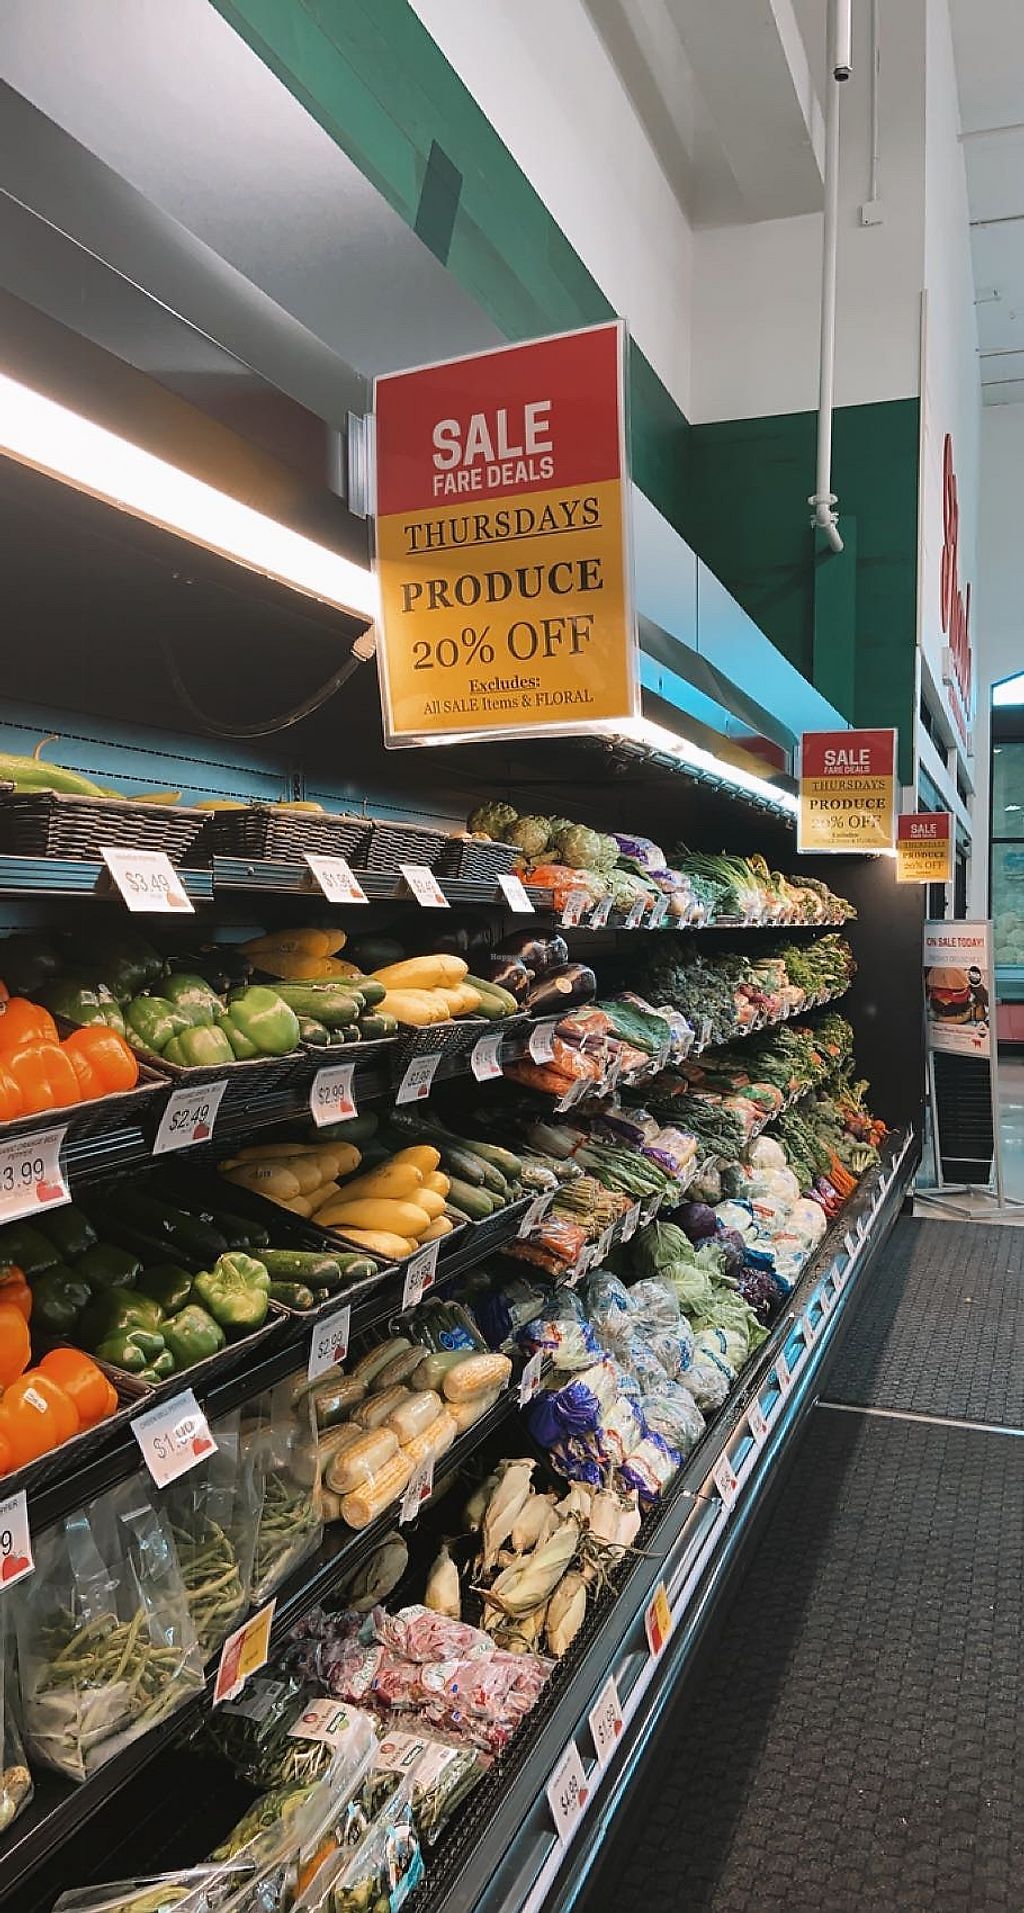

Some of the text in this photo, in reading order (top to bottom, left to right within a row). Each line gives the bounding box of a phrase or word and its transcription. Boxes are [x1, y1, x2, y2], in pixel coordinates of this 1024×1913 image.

[432, 400, 554, 470] SALE
[432, 455, 555, 497] FARE DEALS
[404, 497, 601, 552] THURSDAYS
[401, 558, 604, 613] PRODUCE
[412, 614, 595, 671] 20% OFF
[468, 674, 541, 695] Excludes:
[423, 689, 595, 716] All SALE Items & FLORAL
[823, 749, 871, 767] SALE
[812, 779, 886, 793] THURSDAYS
[809, 797, 886, 811] PRODUCE
[848, 814, 882, 829] OFF
[910, 823, 938, 834] SALE
[903, 851, 945, 859] PRODUCE
[925, 860, 945, 870] OFF
[125, 871, 170, 893] $3.49
[926, 937, 985, 948] ON SALE TODAY!
[169, 1104, 210, 1131] $2.49
[0, 1158, 45, 1191] 3.99
[153, 1420, 196, 1459] $1.99
